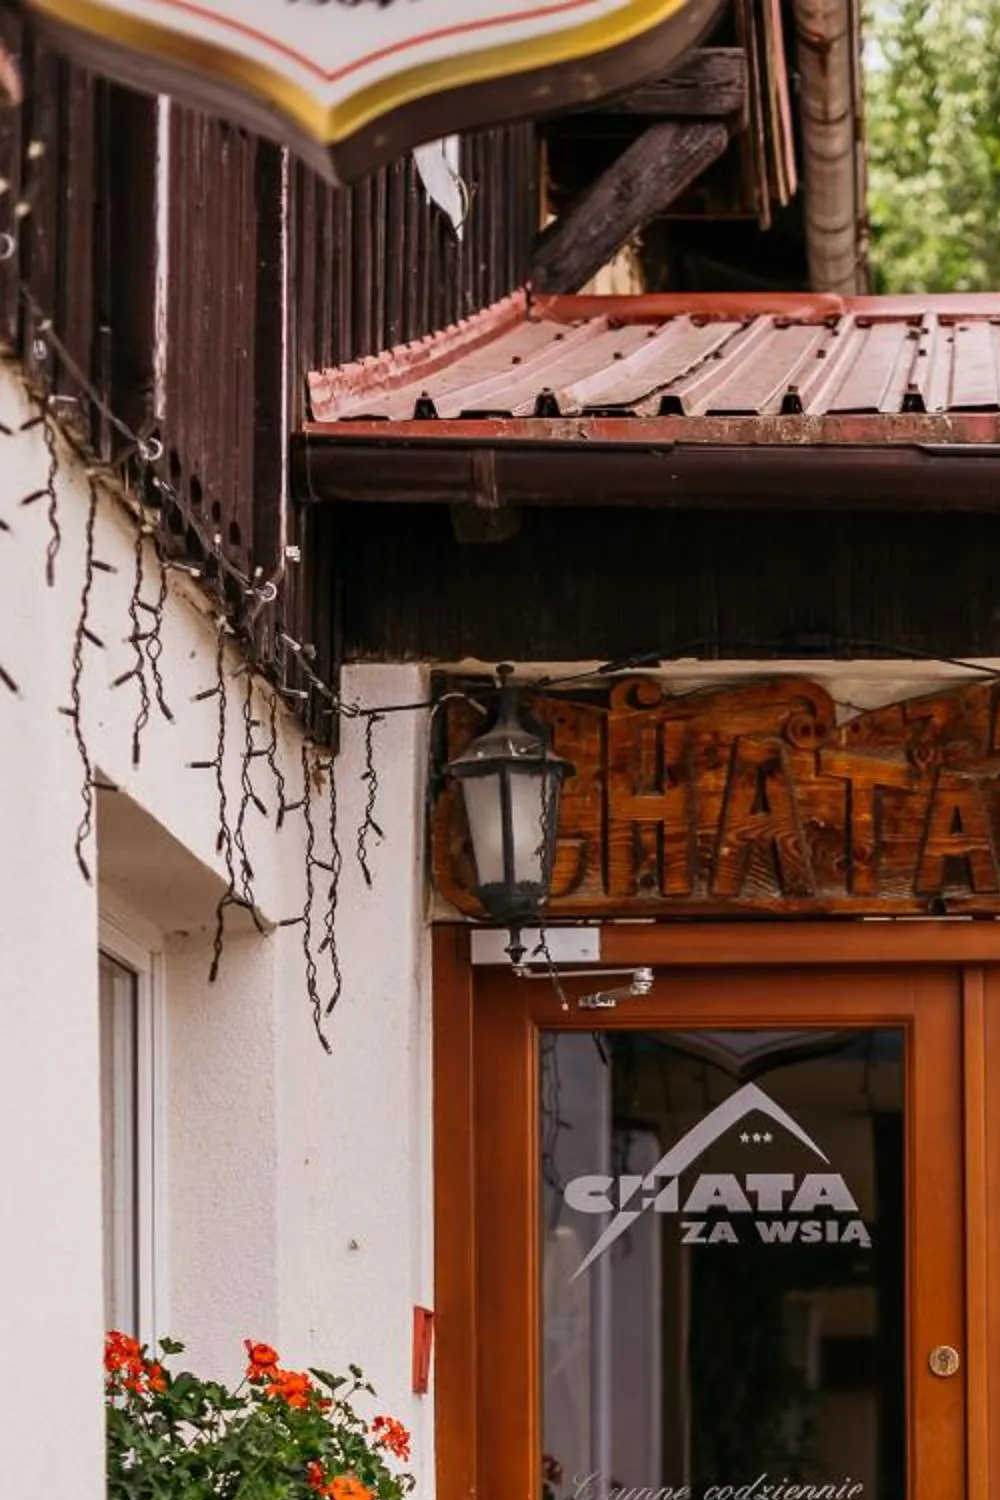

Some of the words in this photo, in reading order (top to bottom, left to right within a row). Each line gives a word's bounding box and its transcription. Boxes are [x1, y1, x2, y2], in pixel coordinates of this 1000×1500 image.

[564, 1173, 859, 1214] CHATA
[680, 1220, 739, 1244] ZA
[755, 1220, 872, 1248] WSIĄ
